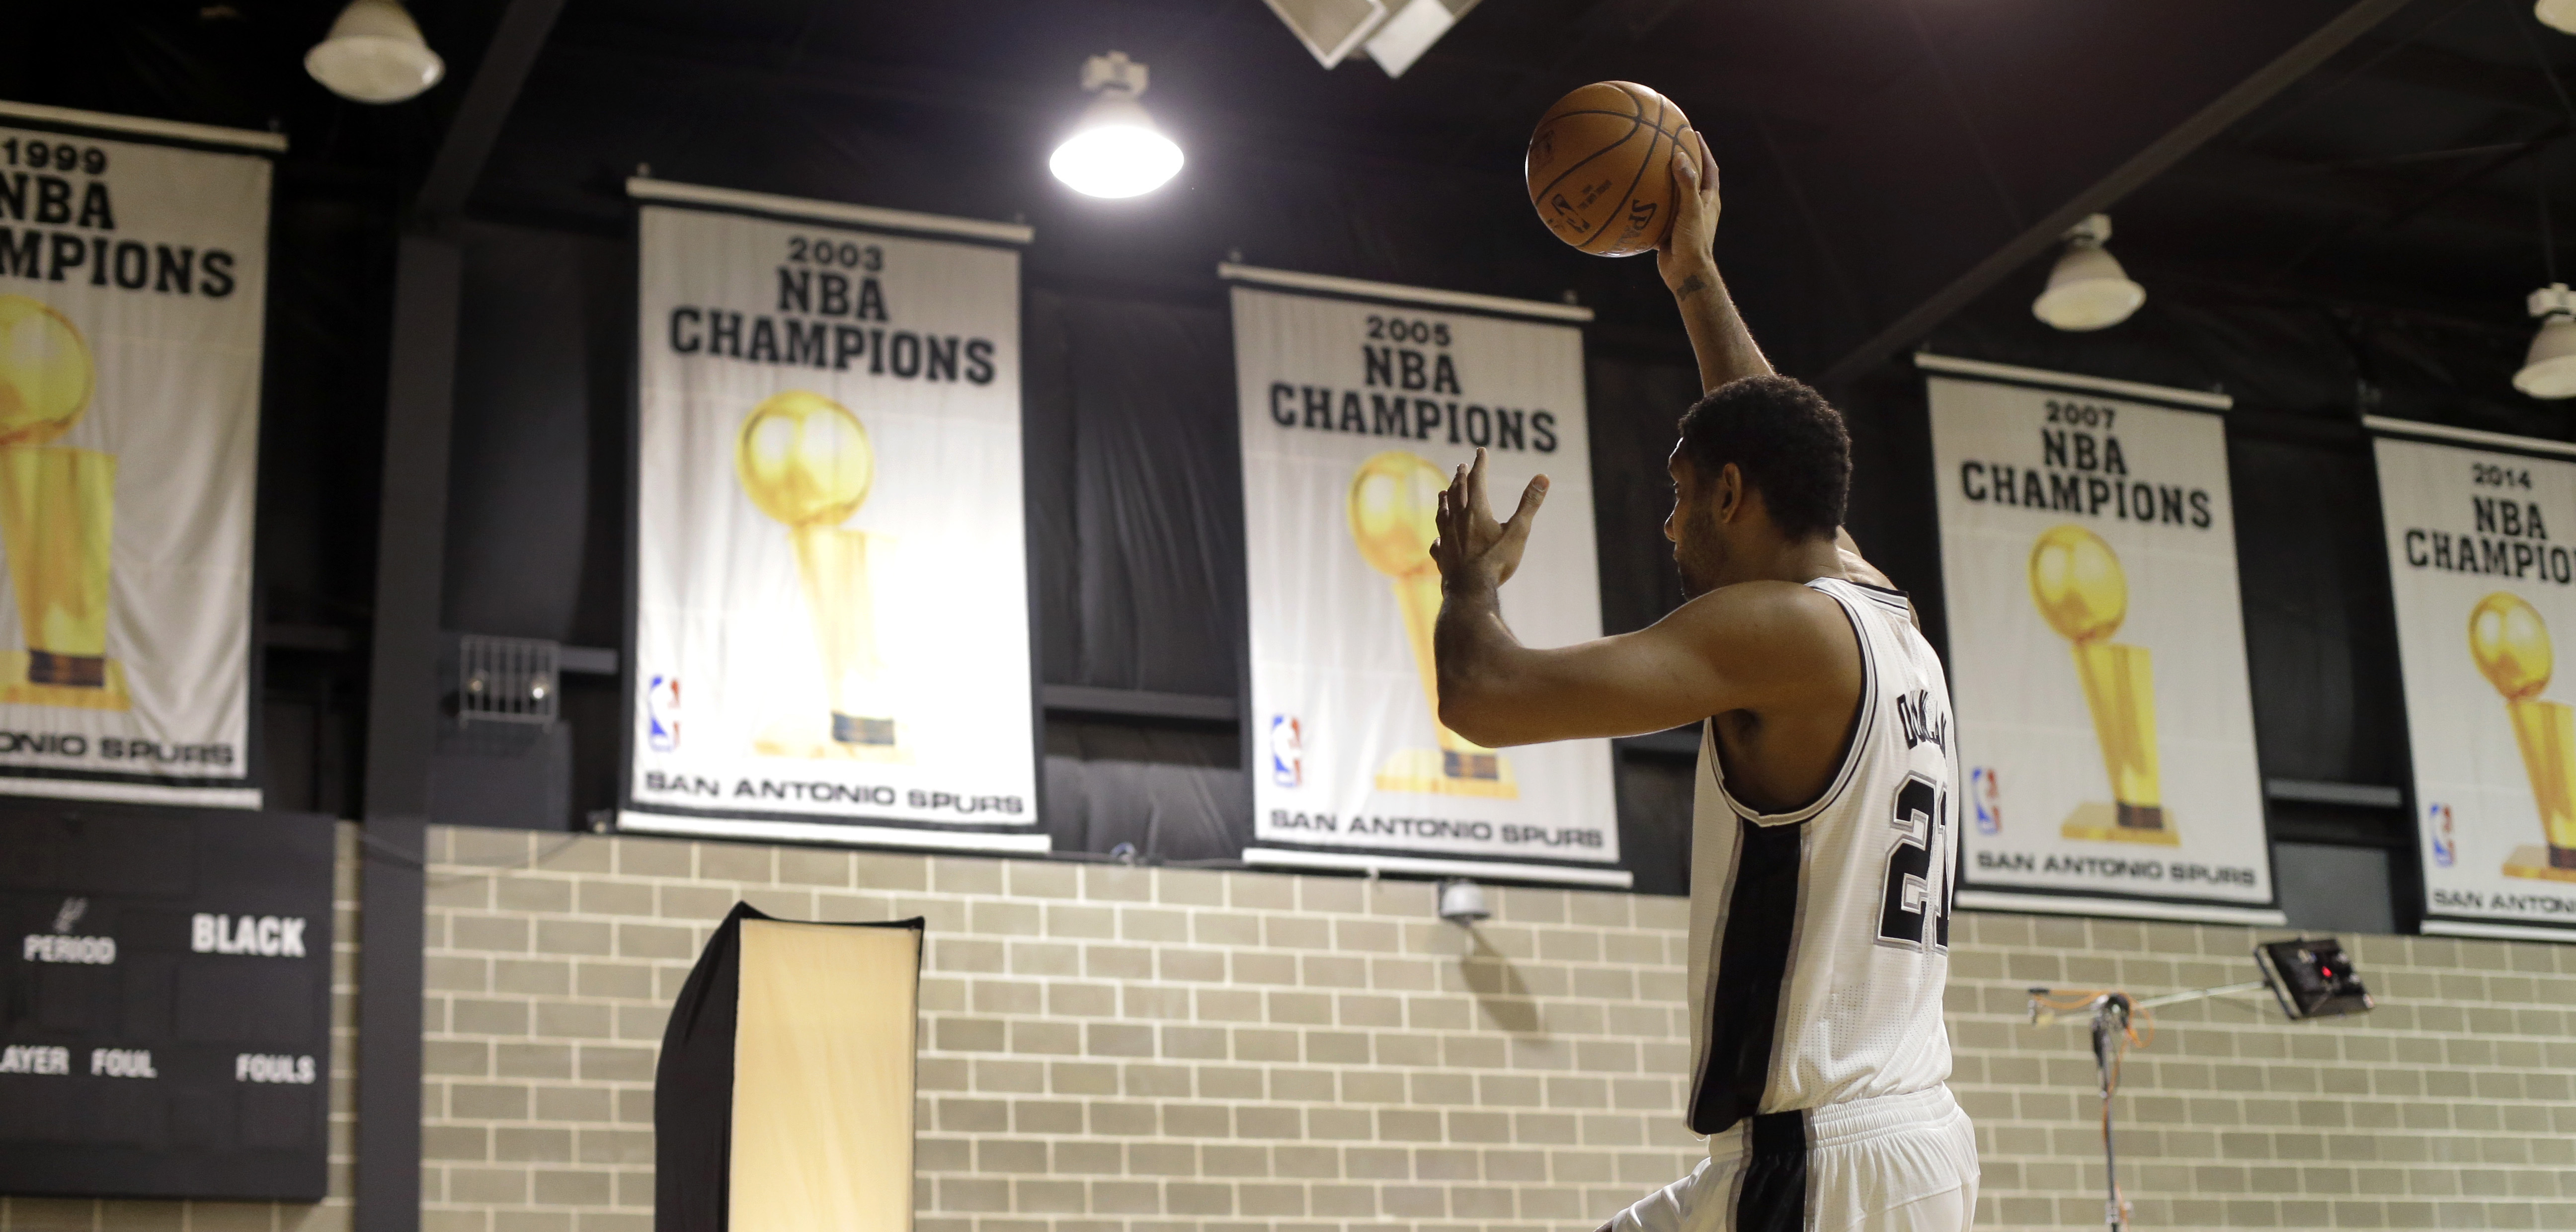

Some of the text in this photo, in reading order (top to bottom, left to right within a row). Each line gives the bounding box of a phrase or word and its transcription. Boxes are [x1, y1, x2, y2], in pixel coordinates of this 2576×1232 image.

[3, 138, 107, 175] 1999
[0, 171, 115, 230] NBA
[788, 236, 884, 272] 2003
[778, 266, 887, 322] NBA
[669, 305, 995, 386] CHAMPIONS
[1367, 315, 1451, 347] 2005
[1362, 344, 1461, 396] NBA
[1269, 381, 1557, 454] CHAMPIONS
[2045, 400, 2115, 430] 2007
[2042, 429, 2127, 475] NBA
[1960, 460, 2211, 529] CHAMPIONS
[2472, 463, 2532, 489] 2014
[2473, 496, 2547, 540] NBA
[2405, 529, 2576, 585] CHAMPIO
[101, 736, 234, 767] SPURS
[645, 771, 1024, 814] SAN ANTONIO SPURS
[1271, 810, 1604, 848] SAN ANTONIO SPURS
[1977, 852, 2255, 887] SAN ANTONIO SPURS
[24, 935, 116, 964] PERIOD
[192, 914, 305, 957] BLACK
[91, 1049, 157, 1078] FOUL
[236, 1054, 316, 1084] FOULS
